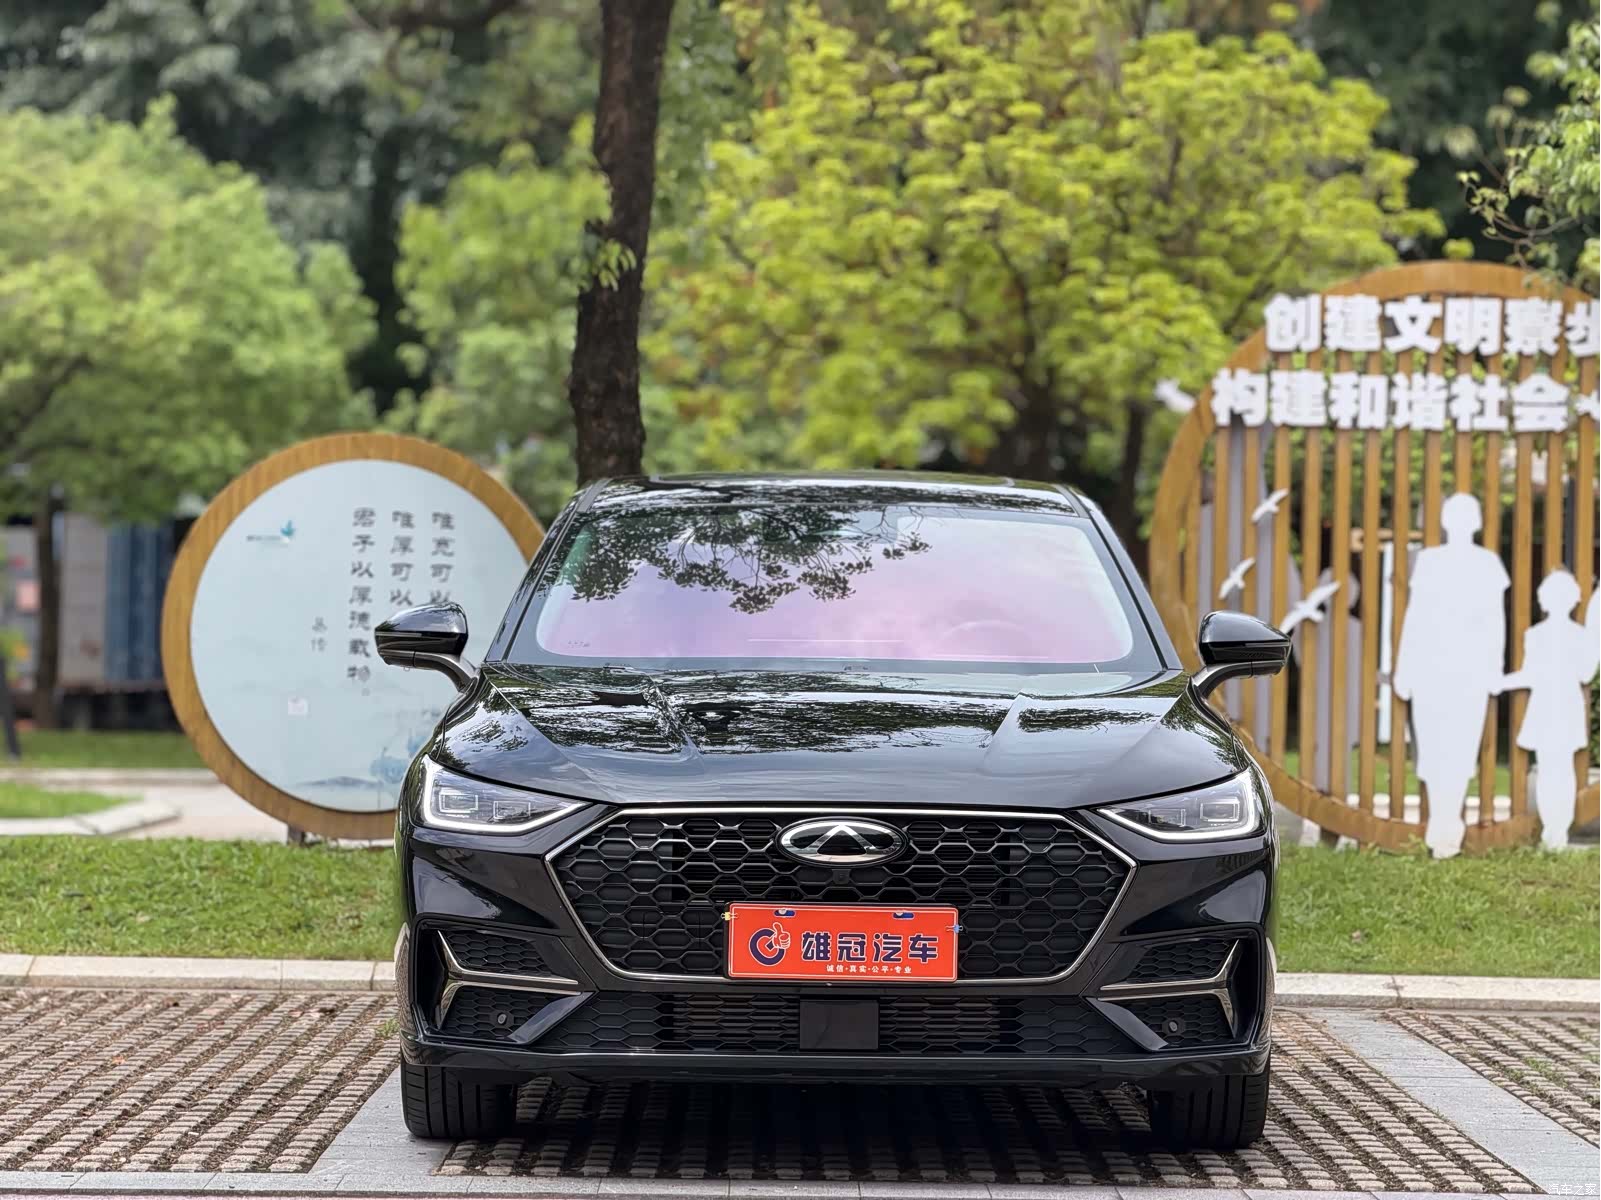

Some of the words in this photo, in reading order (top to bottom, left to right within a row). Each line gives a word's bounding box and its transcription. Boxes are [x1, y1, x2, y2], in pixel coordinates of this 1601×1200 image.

[1211, 367, 1569, 432] 构建和谐社会
[802, 931, 938, 963] 雄冠汽车
